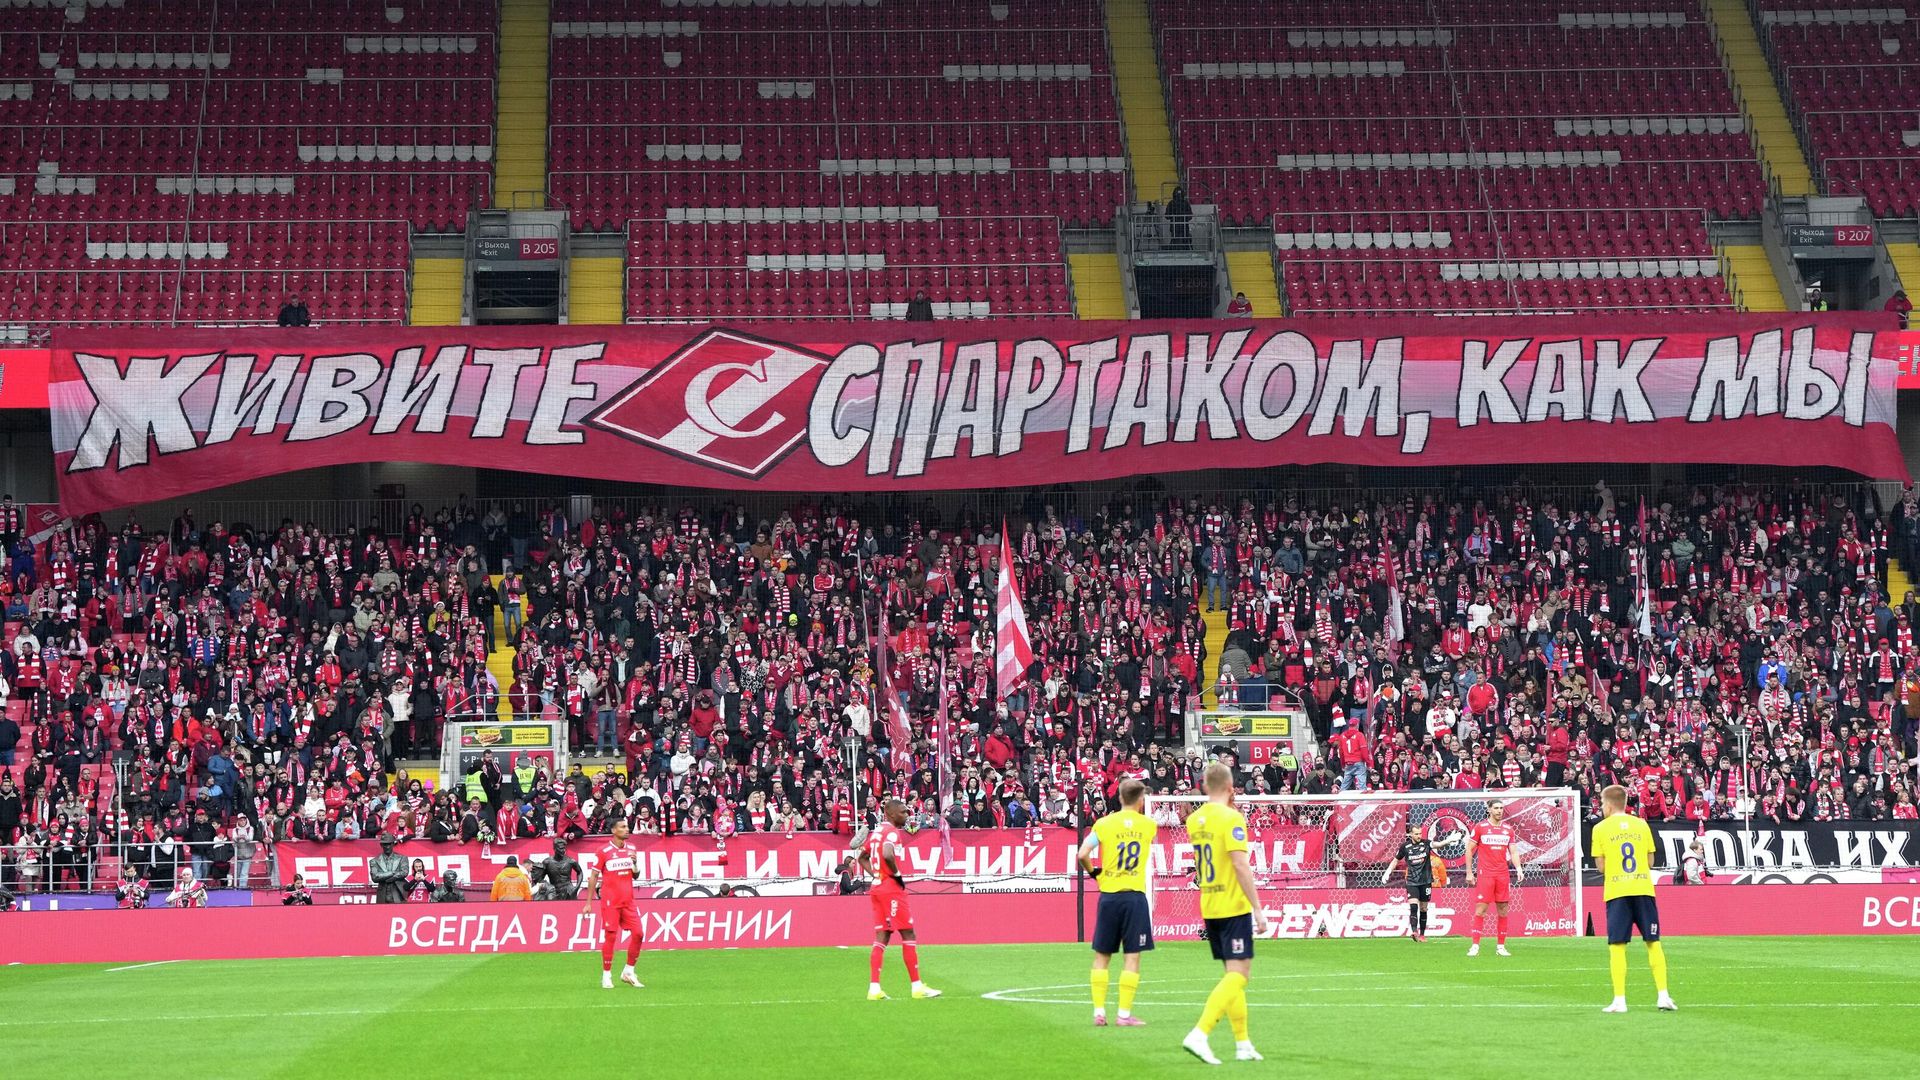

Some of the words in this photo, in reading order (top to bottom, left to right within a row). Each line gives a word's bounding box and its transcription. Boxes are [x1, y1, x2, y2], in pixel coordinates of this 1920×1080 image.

[484, 241, 510, 250] Выход
[1799, 228, 1825, 236] Выход
[1848, 230, 1871, 241] 207
[533, 243, 556, 254] 205
[65, 342, 606, 475] ЖИВИТЕ
[807, 327, 1432, 479] СПАРТАКОМ,
[1456, 335, 1664, 428] КАК
[1687, 325, 1875, 428] МЫ
[1360, 810, 1403, 852] ФКСМ
[745, 849, 778, 879] И
[1117, 841, 1141, 871] 18
[1621, 841, 1637, 874] 8
[1658, 829, 1817, 869] ПОКА
[1833, 830, 1912, 869] ИХ
[388, 914, 527, 952] ВСЕГДА
[539, 913, 559, 946] В
[567, 908, 793, 951] ДИЖЕНИИ
[1524, 918, 1557, 933] Альфа
